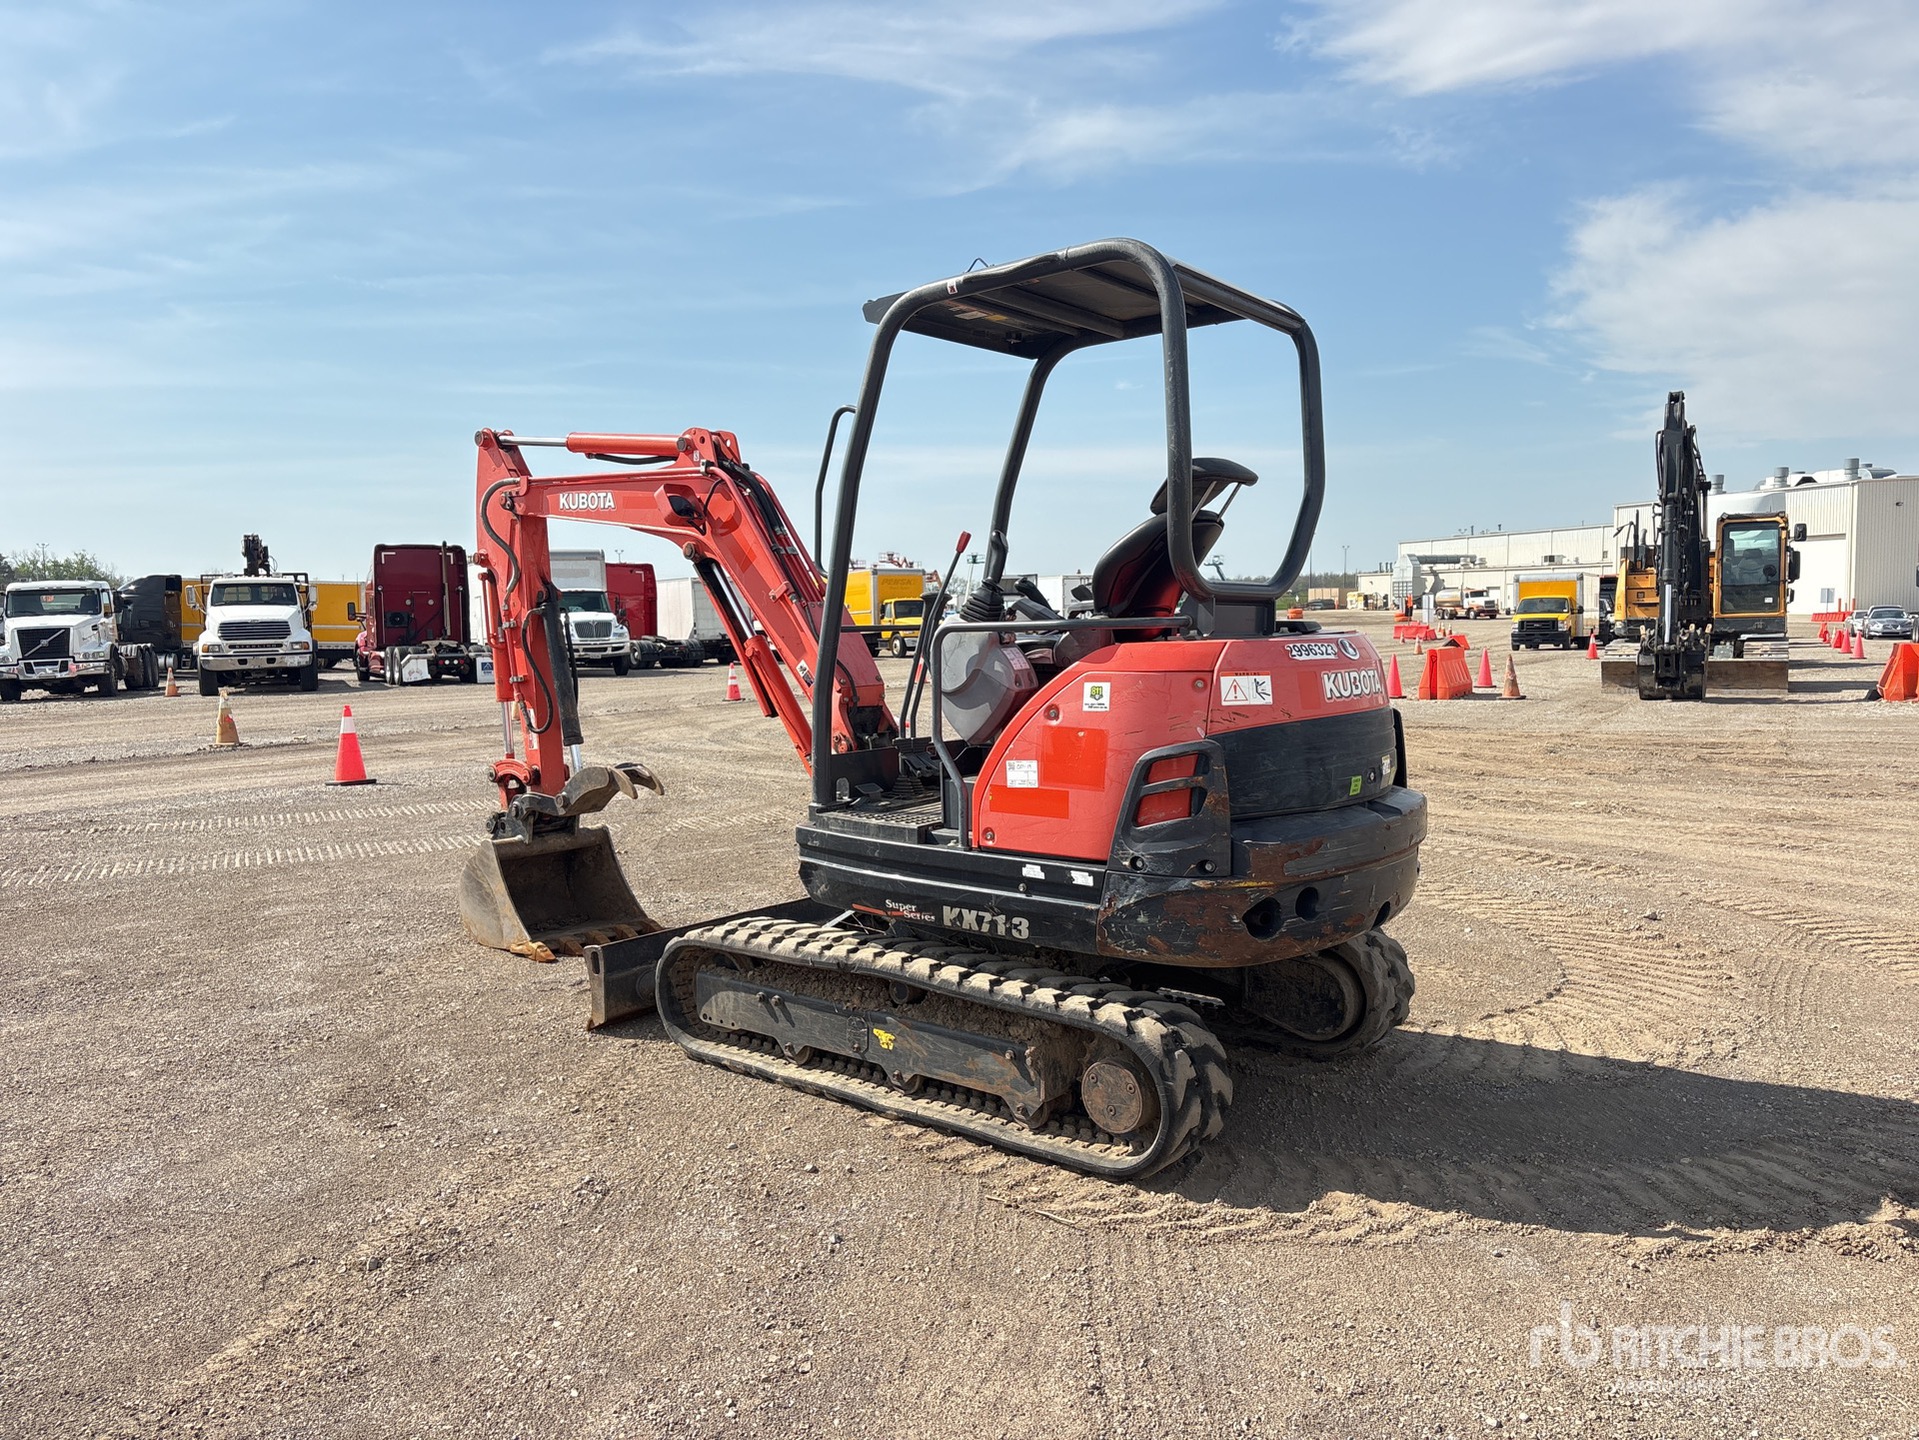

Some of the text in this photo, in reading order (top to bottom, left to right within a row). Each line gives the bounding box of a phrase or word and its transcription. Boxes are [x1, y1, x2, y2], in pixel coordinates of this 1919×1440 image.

[559, 492, 615, 510] KUBOTA
[1286, 643, 1337, 658] 2996323
[1322, 669, 1382, 699] KUBOTA
[885, 898, 917, 912] Super
[903, 909, 936, 922] Series
